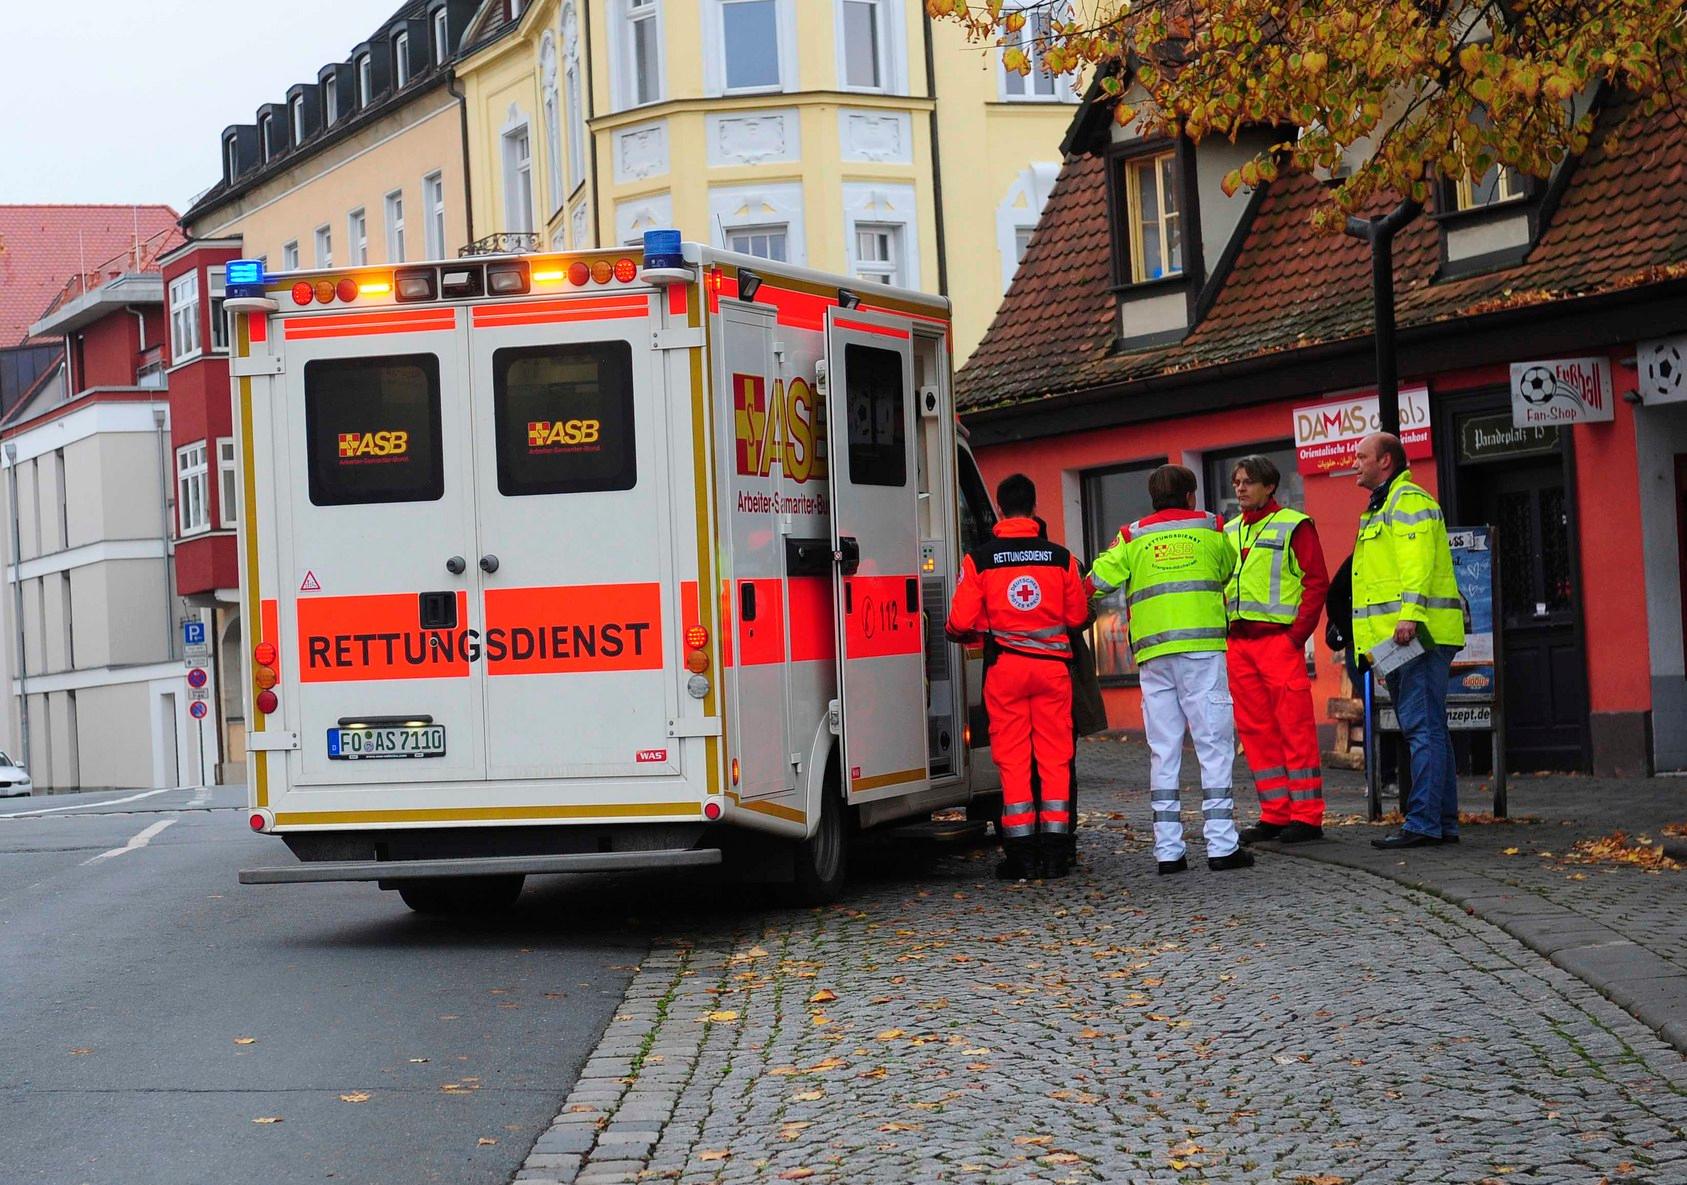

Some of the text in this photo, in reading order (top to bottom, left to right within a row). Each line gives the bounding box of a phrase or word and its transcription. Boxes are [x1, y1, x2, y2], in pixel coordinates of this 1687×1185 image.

[1297, 405, 1366, 442] DAMAS
[1526, 406, 1577, 422] Fan-Shop
[356, 431, 408, 456] ASB
[546, 420, 600, 445] ASB
[1474, 428, 1527, 450] Paradeplatz
[1300, 443, 1345, 460] Orientalische
[1400, 431, 1428, 444] einkost
[737, 490, 828, 515] Arbeiter-Samariter-Bu
[993, 550, 1053, 564] RETTUNGSDIENST
[880, 600, 899, 632] 112
[308, 623, 650, 668] RETTUNGSDIENST
[1447, 707, 1490, 723] nzept.de
[340, 732, 362, 752] FO
[375, 731, 396, 751] AS
[400, 730, 442, 750] 7110
[640, 752, 662, 760] WAS
